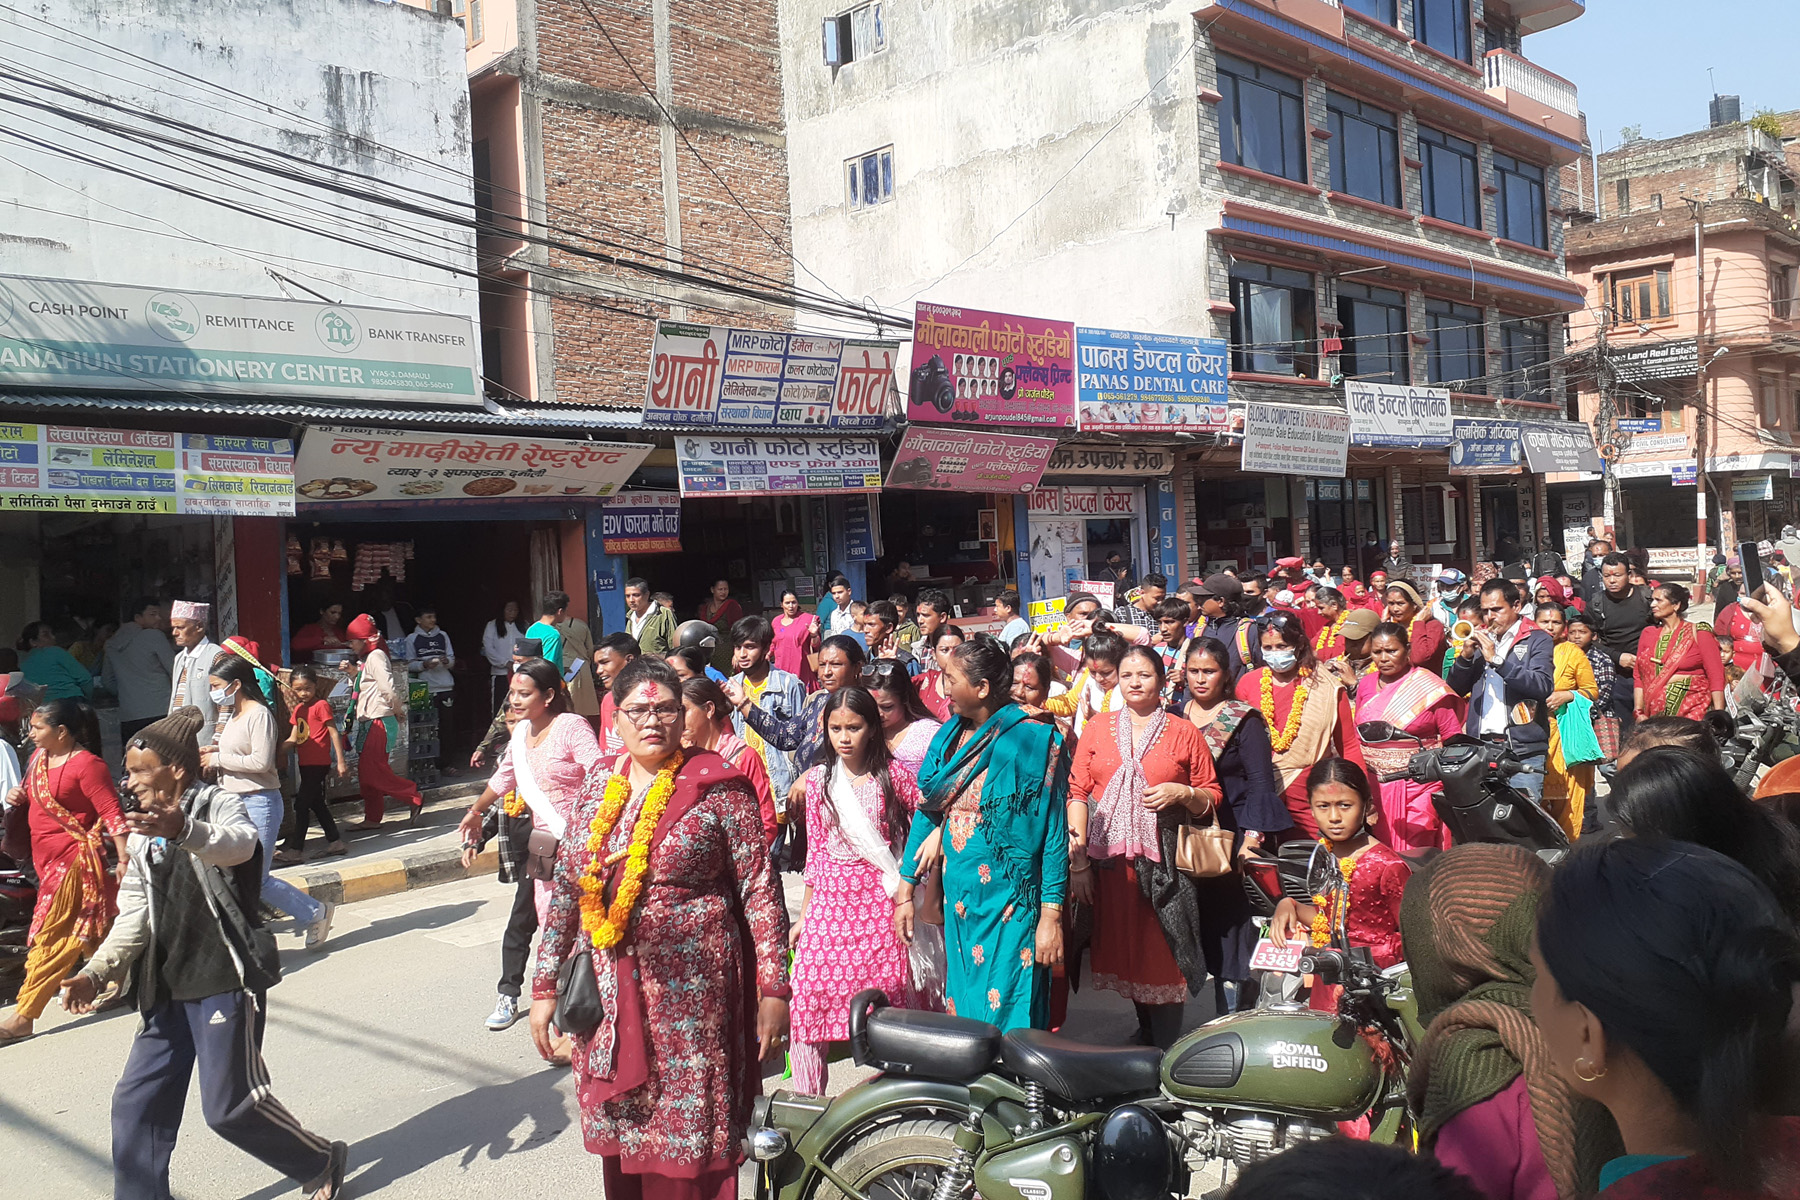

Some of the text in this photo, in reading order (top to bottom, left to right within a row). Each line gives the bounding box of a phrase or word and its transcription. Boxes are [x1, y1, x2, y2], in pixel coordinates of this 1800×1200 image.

[28, 301, 129, 320] CASH POINT
[205, 314, 295, 332] REMITTANCE
[368, 328, 466, 347] BANK TRANSFER
[732, 334, 785, 351] MRP फोटो
[791, 338, 814, 353] ईमेल
[917, 312, 1071, 367] मौलाकाली फोटो स्टुडियो
[1080, 342, 1224, 377] पानस डेण्टल केयर
[1627, 349, 1648, 360] Land
[1650, 347, 1668, 357] Real
[1669, 346, 1698, 355] Estate
[1647, 356, 1678, 364] Construction
[0, 347, 365, 384] ANAHUN STATIONERY CENTER
[397, 371, 431, 379] DAMAULI
[652, 339, 720, 410] थानी
[727, 359, 781, 374] MRP फाराम
[837, 350, 893, 415] फोटो
[1080, 373, 1225, 395] PANAS DENTAL CARE
[1351, 387, 1447, 418] पदम डेन्टल क्लिनिक
[780, 408, 803, 421] छाप
[1248, 405, 1270, 423] GLOBAL
[1271, 408, 1300, 427] COMPUTER
[1305, 412, 1322, 429] SURAJ
[1322, 415, 1349, 432] COMPUTER
[1250, 423, 1276, 439] Computer
[1276, 427, 1286, 439] Sale
[1288, 428, 1312, 441] Education
[1316, 431, 1345, 444] Maintenance
[1650, 437, 1686, 446] CONSULTANCY
[252, 437, 270, 450] सेवा
[330, 438, 385, 464] न्यू
[709, 437, 877, 459] थानी फोटो स्टुडियो
[905, 433, 973, 455] मौलाकाली
[973, 440, 1006, 456] फोटो
[1077, 448, 1163, 470] उपचार सेवा
[9, 494, 59, 509] समितिको
[64, 494, 86, 508] पैसा
[1103, 486, 1132, 512] केयर
[603, 515, 622, 534] EDV
[623, 514, 651, 534] फाराम
[1276, 1041, 1321, 1056] ROYAL
[1273, 1055, 1328, 1072] ENFIELD
